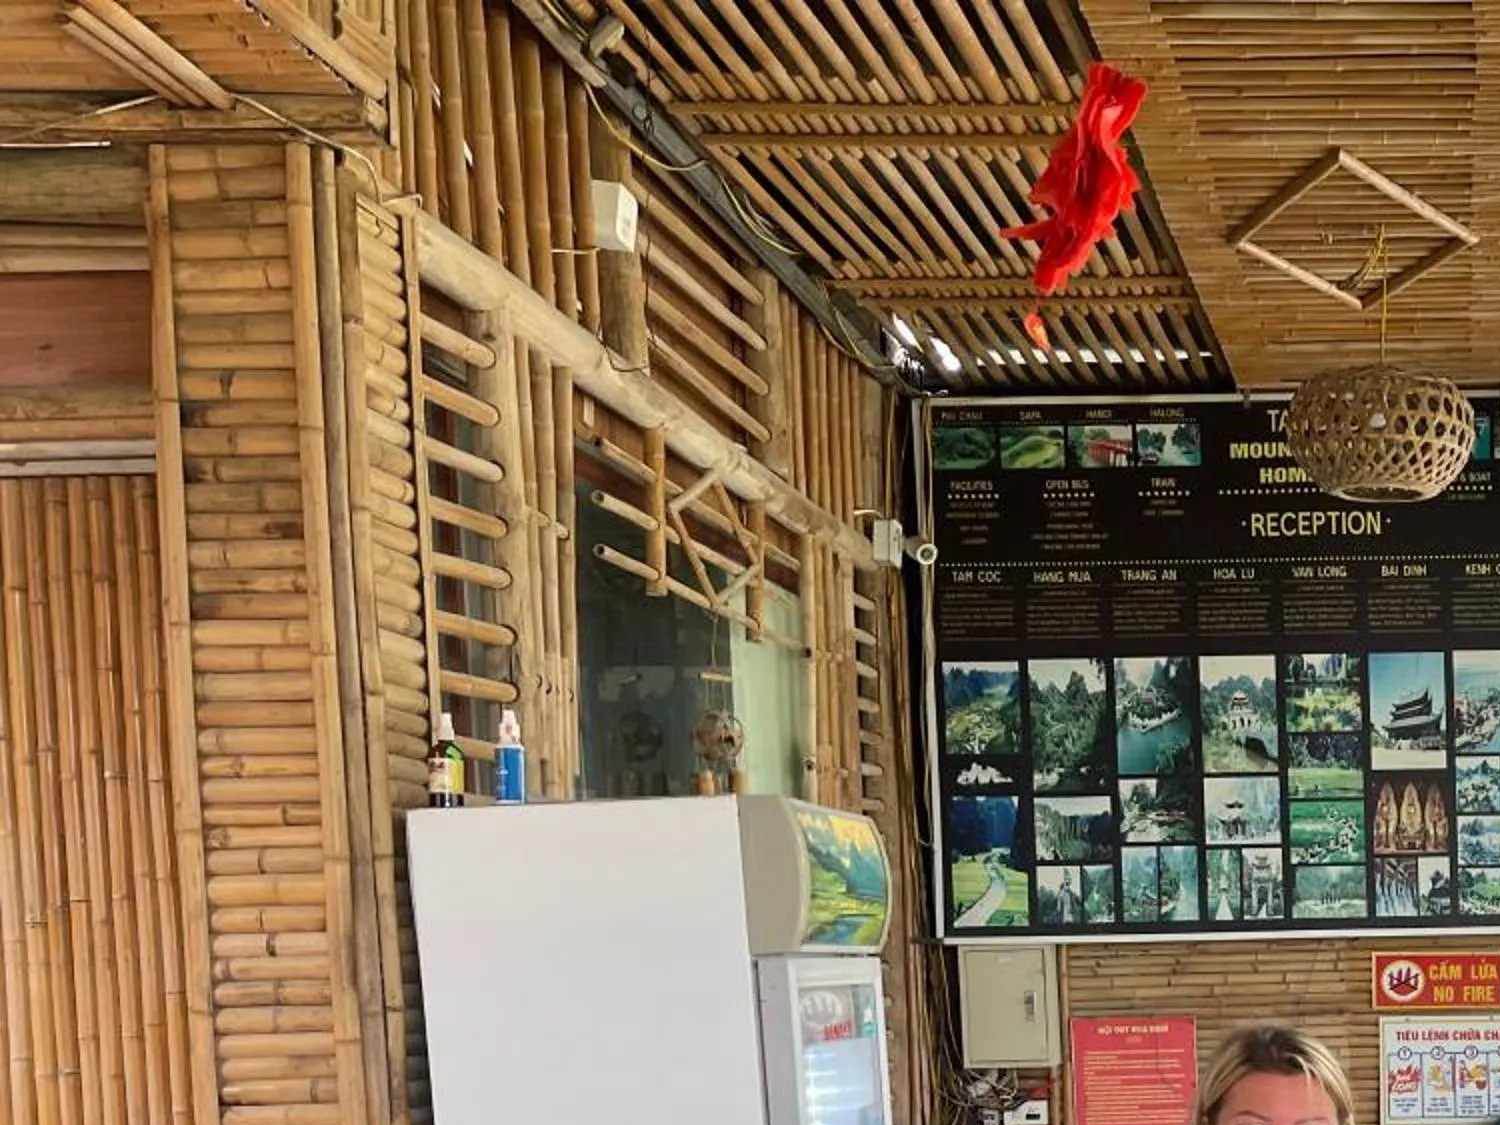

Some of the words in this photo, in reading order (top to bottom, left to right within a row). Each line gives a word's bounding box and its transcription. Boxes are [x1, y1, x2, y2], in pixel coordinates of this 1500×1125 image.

[1230, 442, 1293, 459] MOUN
[1260, 467, 1313, 484] HOM
[1151, 477, 1175, 488] TRAIN
[1251, 511, 1382, 537] RECEPTION
[952, 571, 973, 582] TAM
[1033, 571, 1064, 582] HANG
[1068, 571, 1092, 582] MUA
[1120, 569, 1157, 581] TRANG
[1161, 570, 1177, 580] AN
[1213, 568, 1236, 579] HOA
[1241, 568, 1255, 578] LU
[1318, 565, 1347, 577] LONG
[1381, 565, 1399, 576] BAI
[1433, 985, 1455, 1002] NO
[1463, 985, 1496, 1002] FIRE
